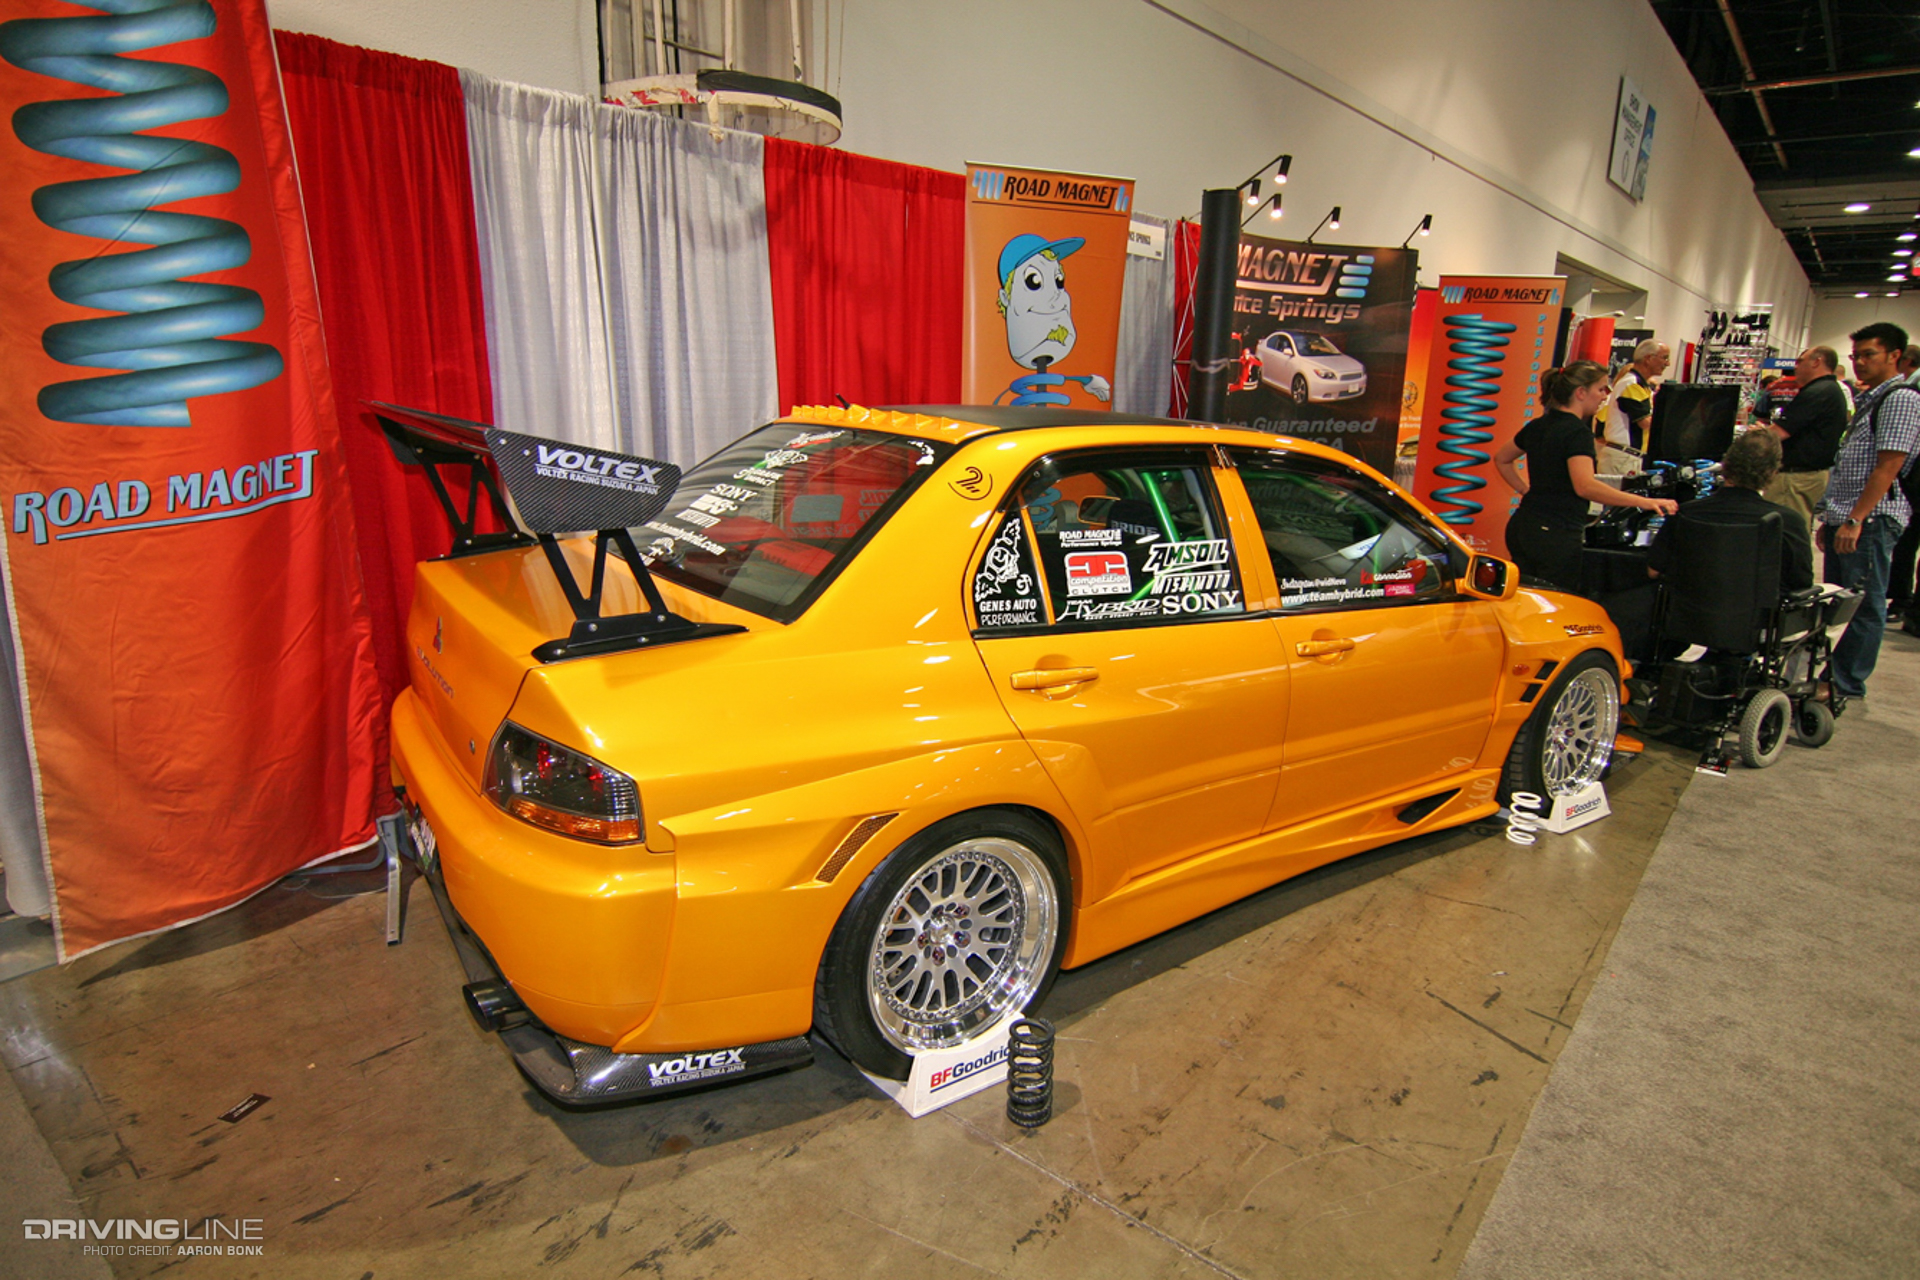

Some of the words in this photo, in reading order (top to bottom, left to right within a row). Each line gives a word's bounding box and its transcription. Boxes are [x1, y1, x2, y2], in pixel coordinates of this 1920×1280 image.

[1004, 176, 1051, 200] ROAD
[1054, 181, 1118, 208] MAGNET
[1237, 243, 1349, 294] MAGNET
[1464, 287, 1499, 303] ROAD
[1501, 288, 1551, 304] MAGNET
[1267, 294, 1361, 324] Springs
[1252, 417, 1378, 434] Guaranteed
[537, 444, 663, 484] VOLTEX
[13, 480, 150, 545] ROAD
[167, 449, 319, 513] MAGNET
[710, 484, 758, 502] SONY
[1059, 530, 1083, 543] ROAD
[1144, 540, 1229, 571] AMSOIL
[1070, 573, 1128, 586] competition
[1071, 586, 1130, 595] CLUTCH
[980, 599, 1012, 612] GENES
[1012, 599, 1037, 611] AUTO
[1162, 590, 1239, 615] SONY
[1280, 588, 1384, 604] www.teamhybrid.com
[648, 1047, 745, 1078] VOLTEX
[930, 1045, 1010, 1088] BFGoodric
